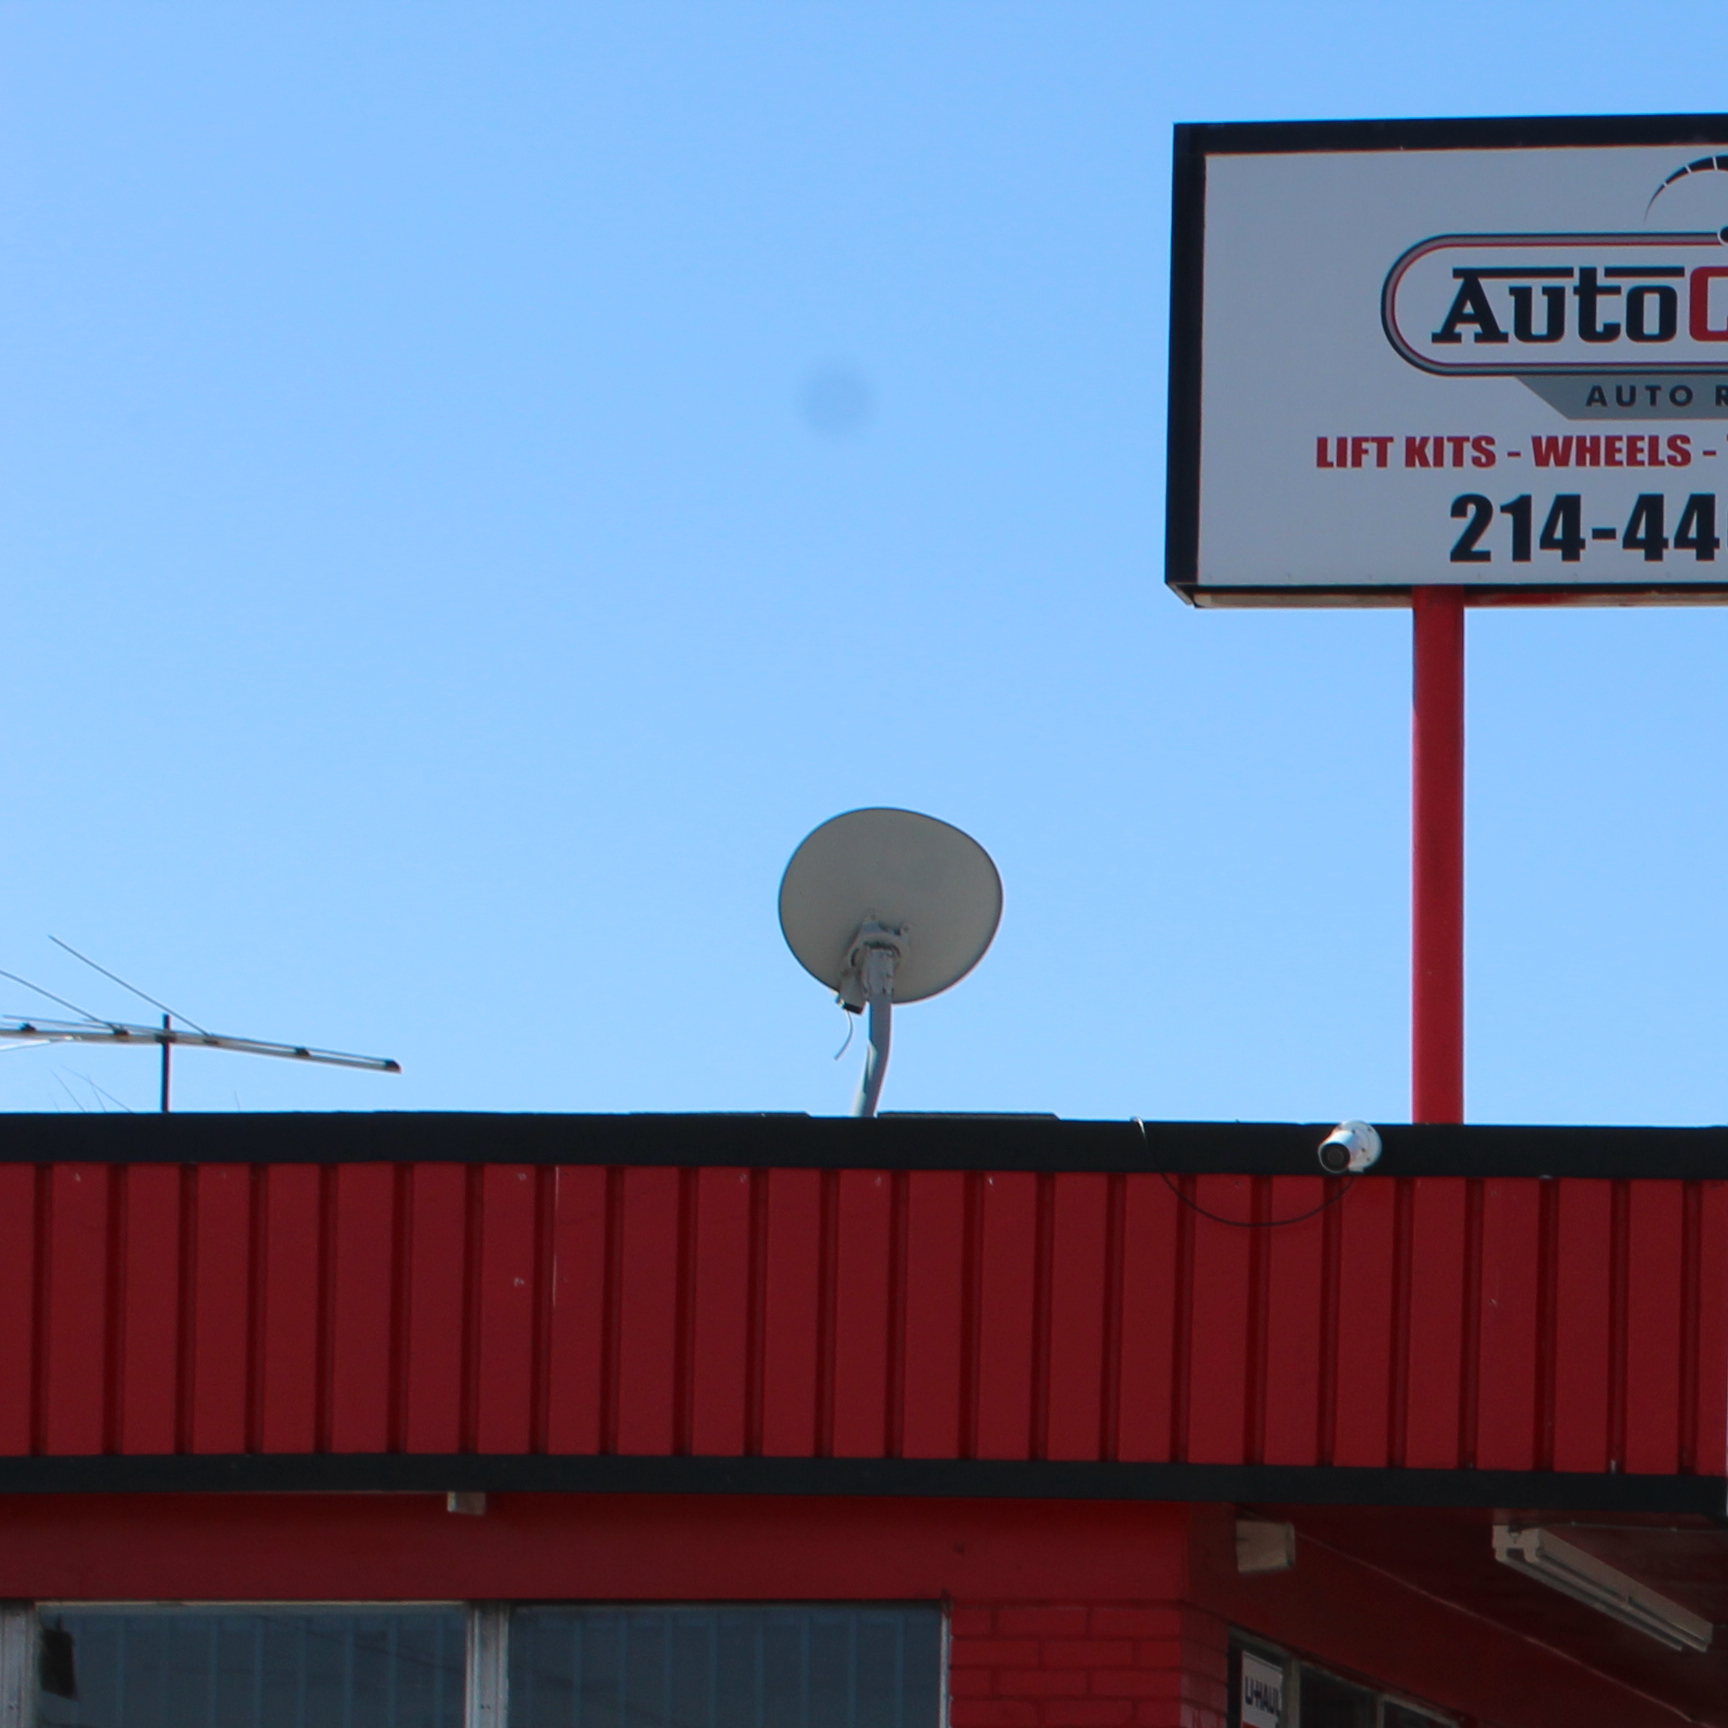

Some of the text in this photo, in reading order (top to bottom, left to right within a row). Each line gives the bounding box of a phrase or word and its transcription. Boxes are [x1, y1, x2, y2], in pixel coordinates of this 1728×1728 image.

[1585, 384, 1694, 408] AUTO
[1316, 436, 1394, 468] LIFT
[1404, 435, 1496, 468] KITS
[1531, 434, 1692, 467] WHEELS
